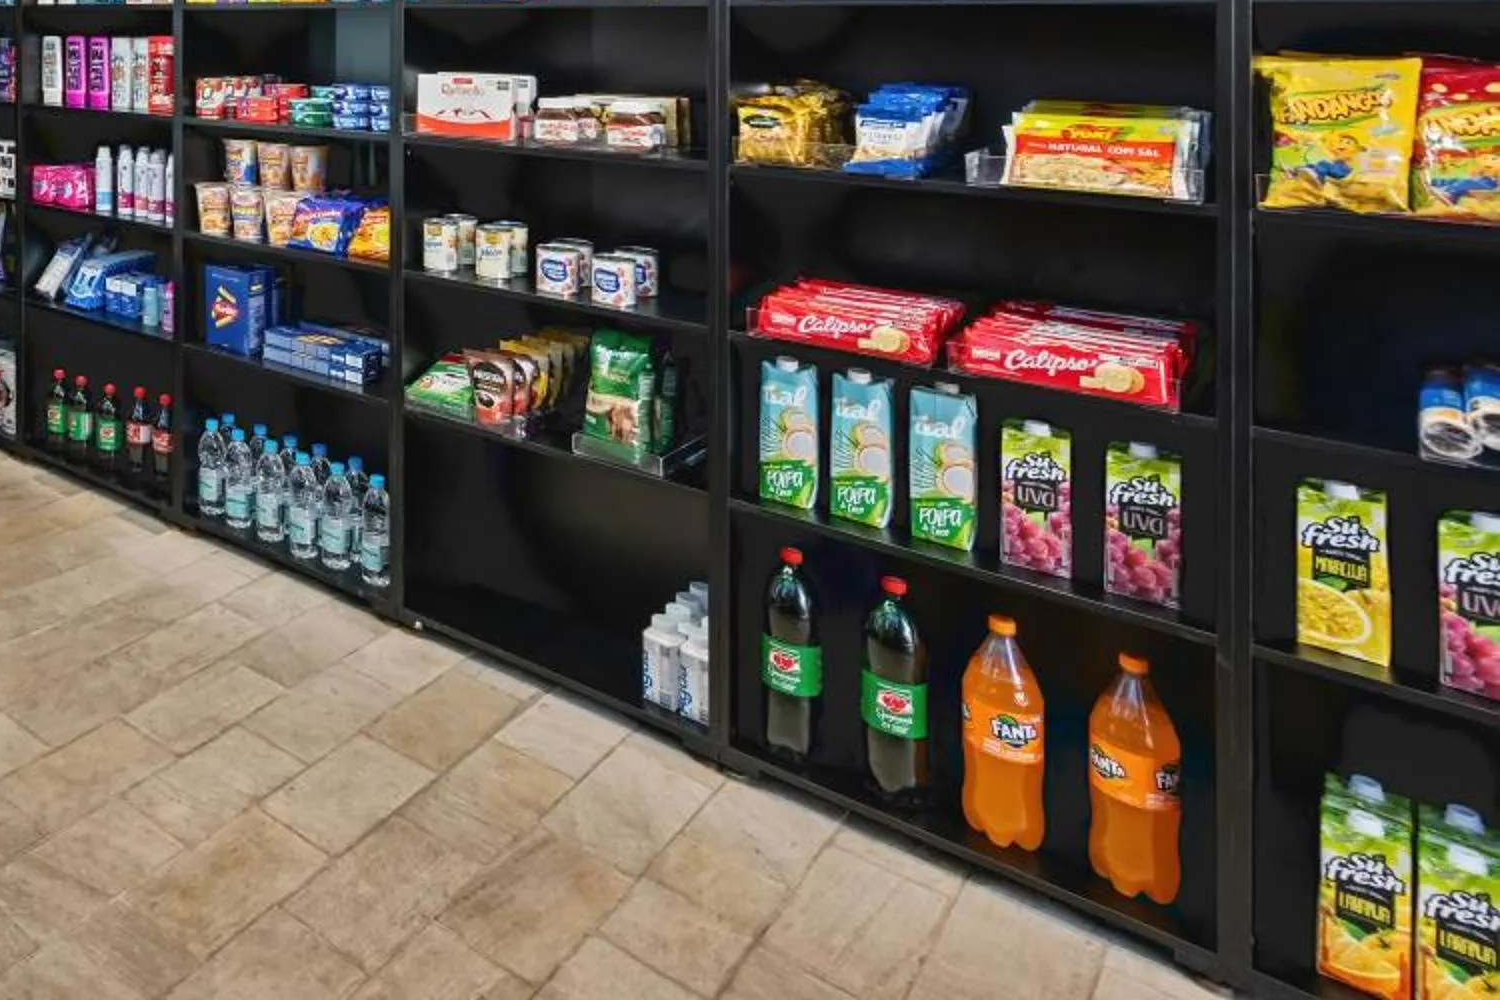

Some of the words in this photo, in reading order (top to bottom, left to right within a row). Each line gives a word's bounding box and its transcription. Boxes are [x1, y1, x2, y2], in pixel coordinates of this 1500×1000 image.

[1048, 142, 1103, 153] NATURAL
[1107, 145, 1134, 155] COM
[1138, 148, 1159, 157] SAL
[800, 314, 869, 338] Calipso
[1005, 349, 1092, 376] Calipso
[1007, 460, 1065, 481] fresh
[1111, 484, 1174, 507] fresh
[1302, 523, 1380, 551] fresh
[1446, 558, 1500, 585] fres
[1461, 591, 1500, 618] UV
[1327, 857, 1404, 893] fresh
